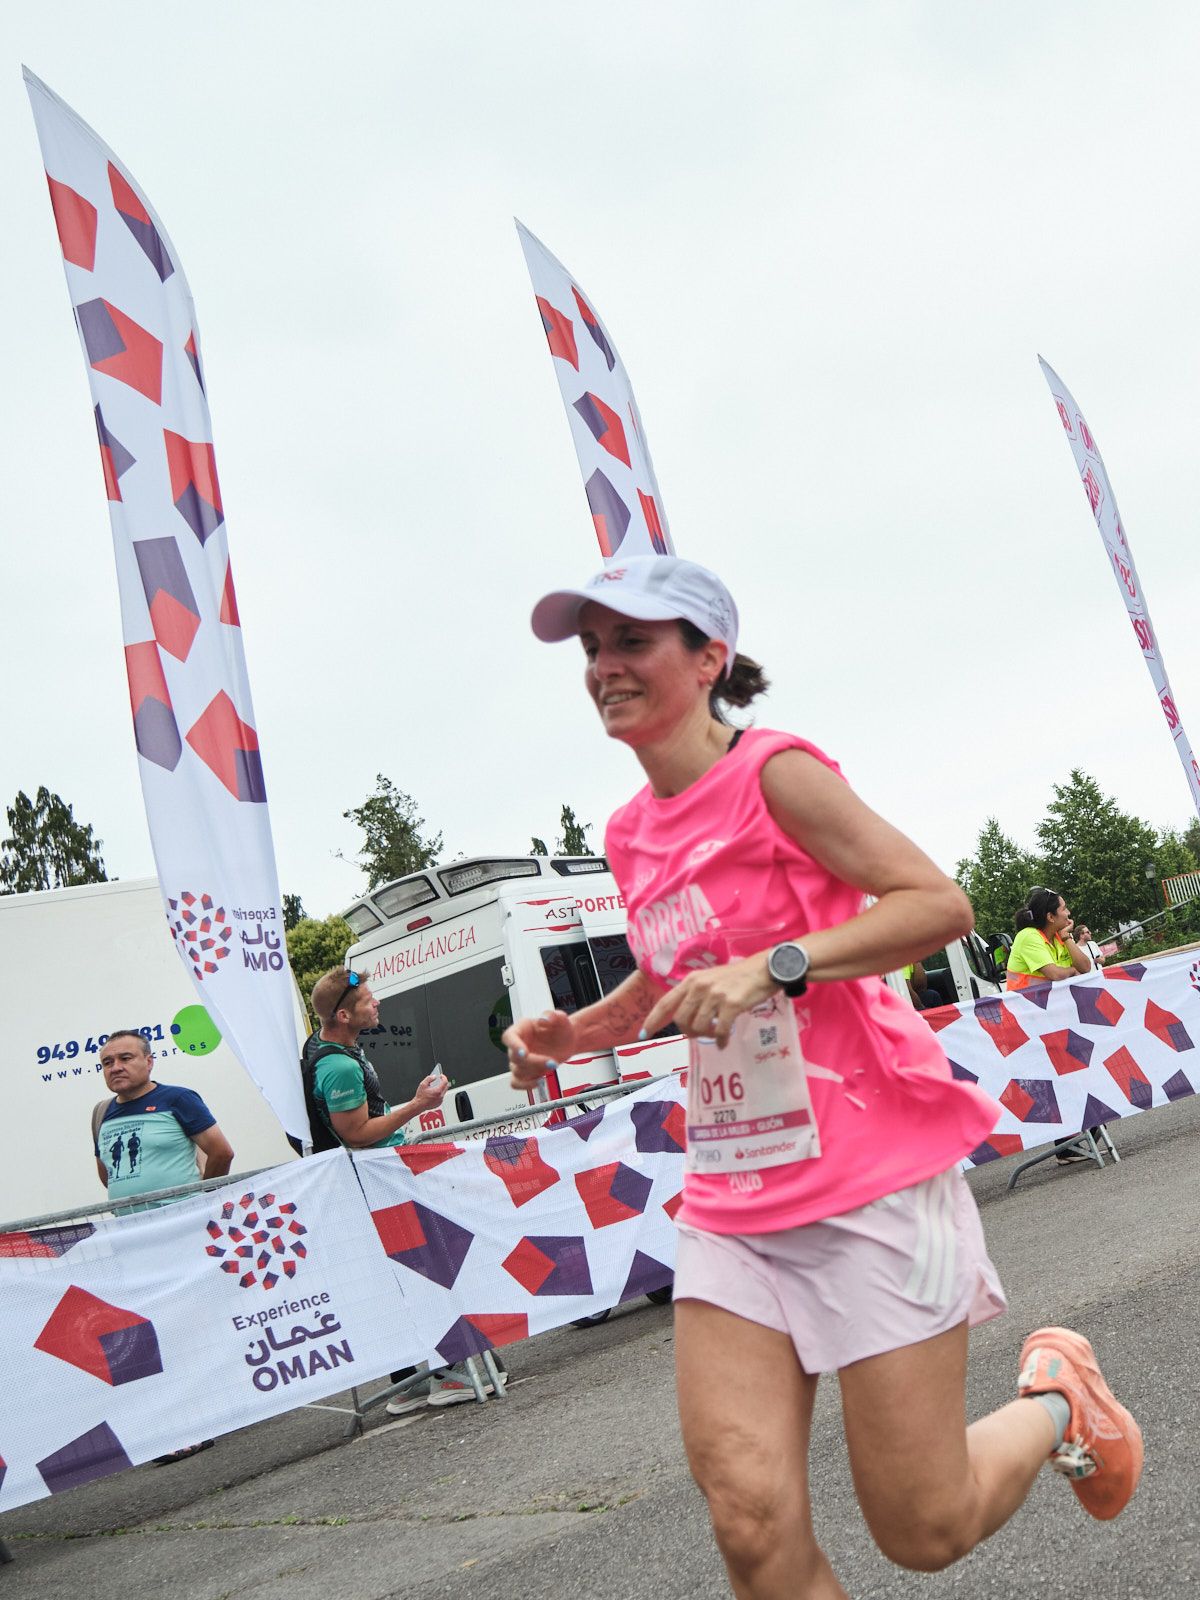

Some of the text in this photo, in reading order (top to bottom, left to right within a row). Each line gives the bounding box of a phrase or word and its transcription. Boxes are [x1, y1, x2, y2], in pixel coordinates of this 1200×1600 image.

[373, 925, 476, 980] AMBULANCIA
[37, 1041, 79, 1065] 949
[713, 1109, 737, 1123] 2270
[744, 1141, 797, 1159] Santander
[232, 1292, 331, 1331] Experience
[252, 1340, 354, 1391] OMAN
